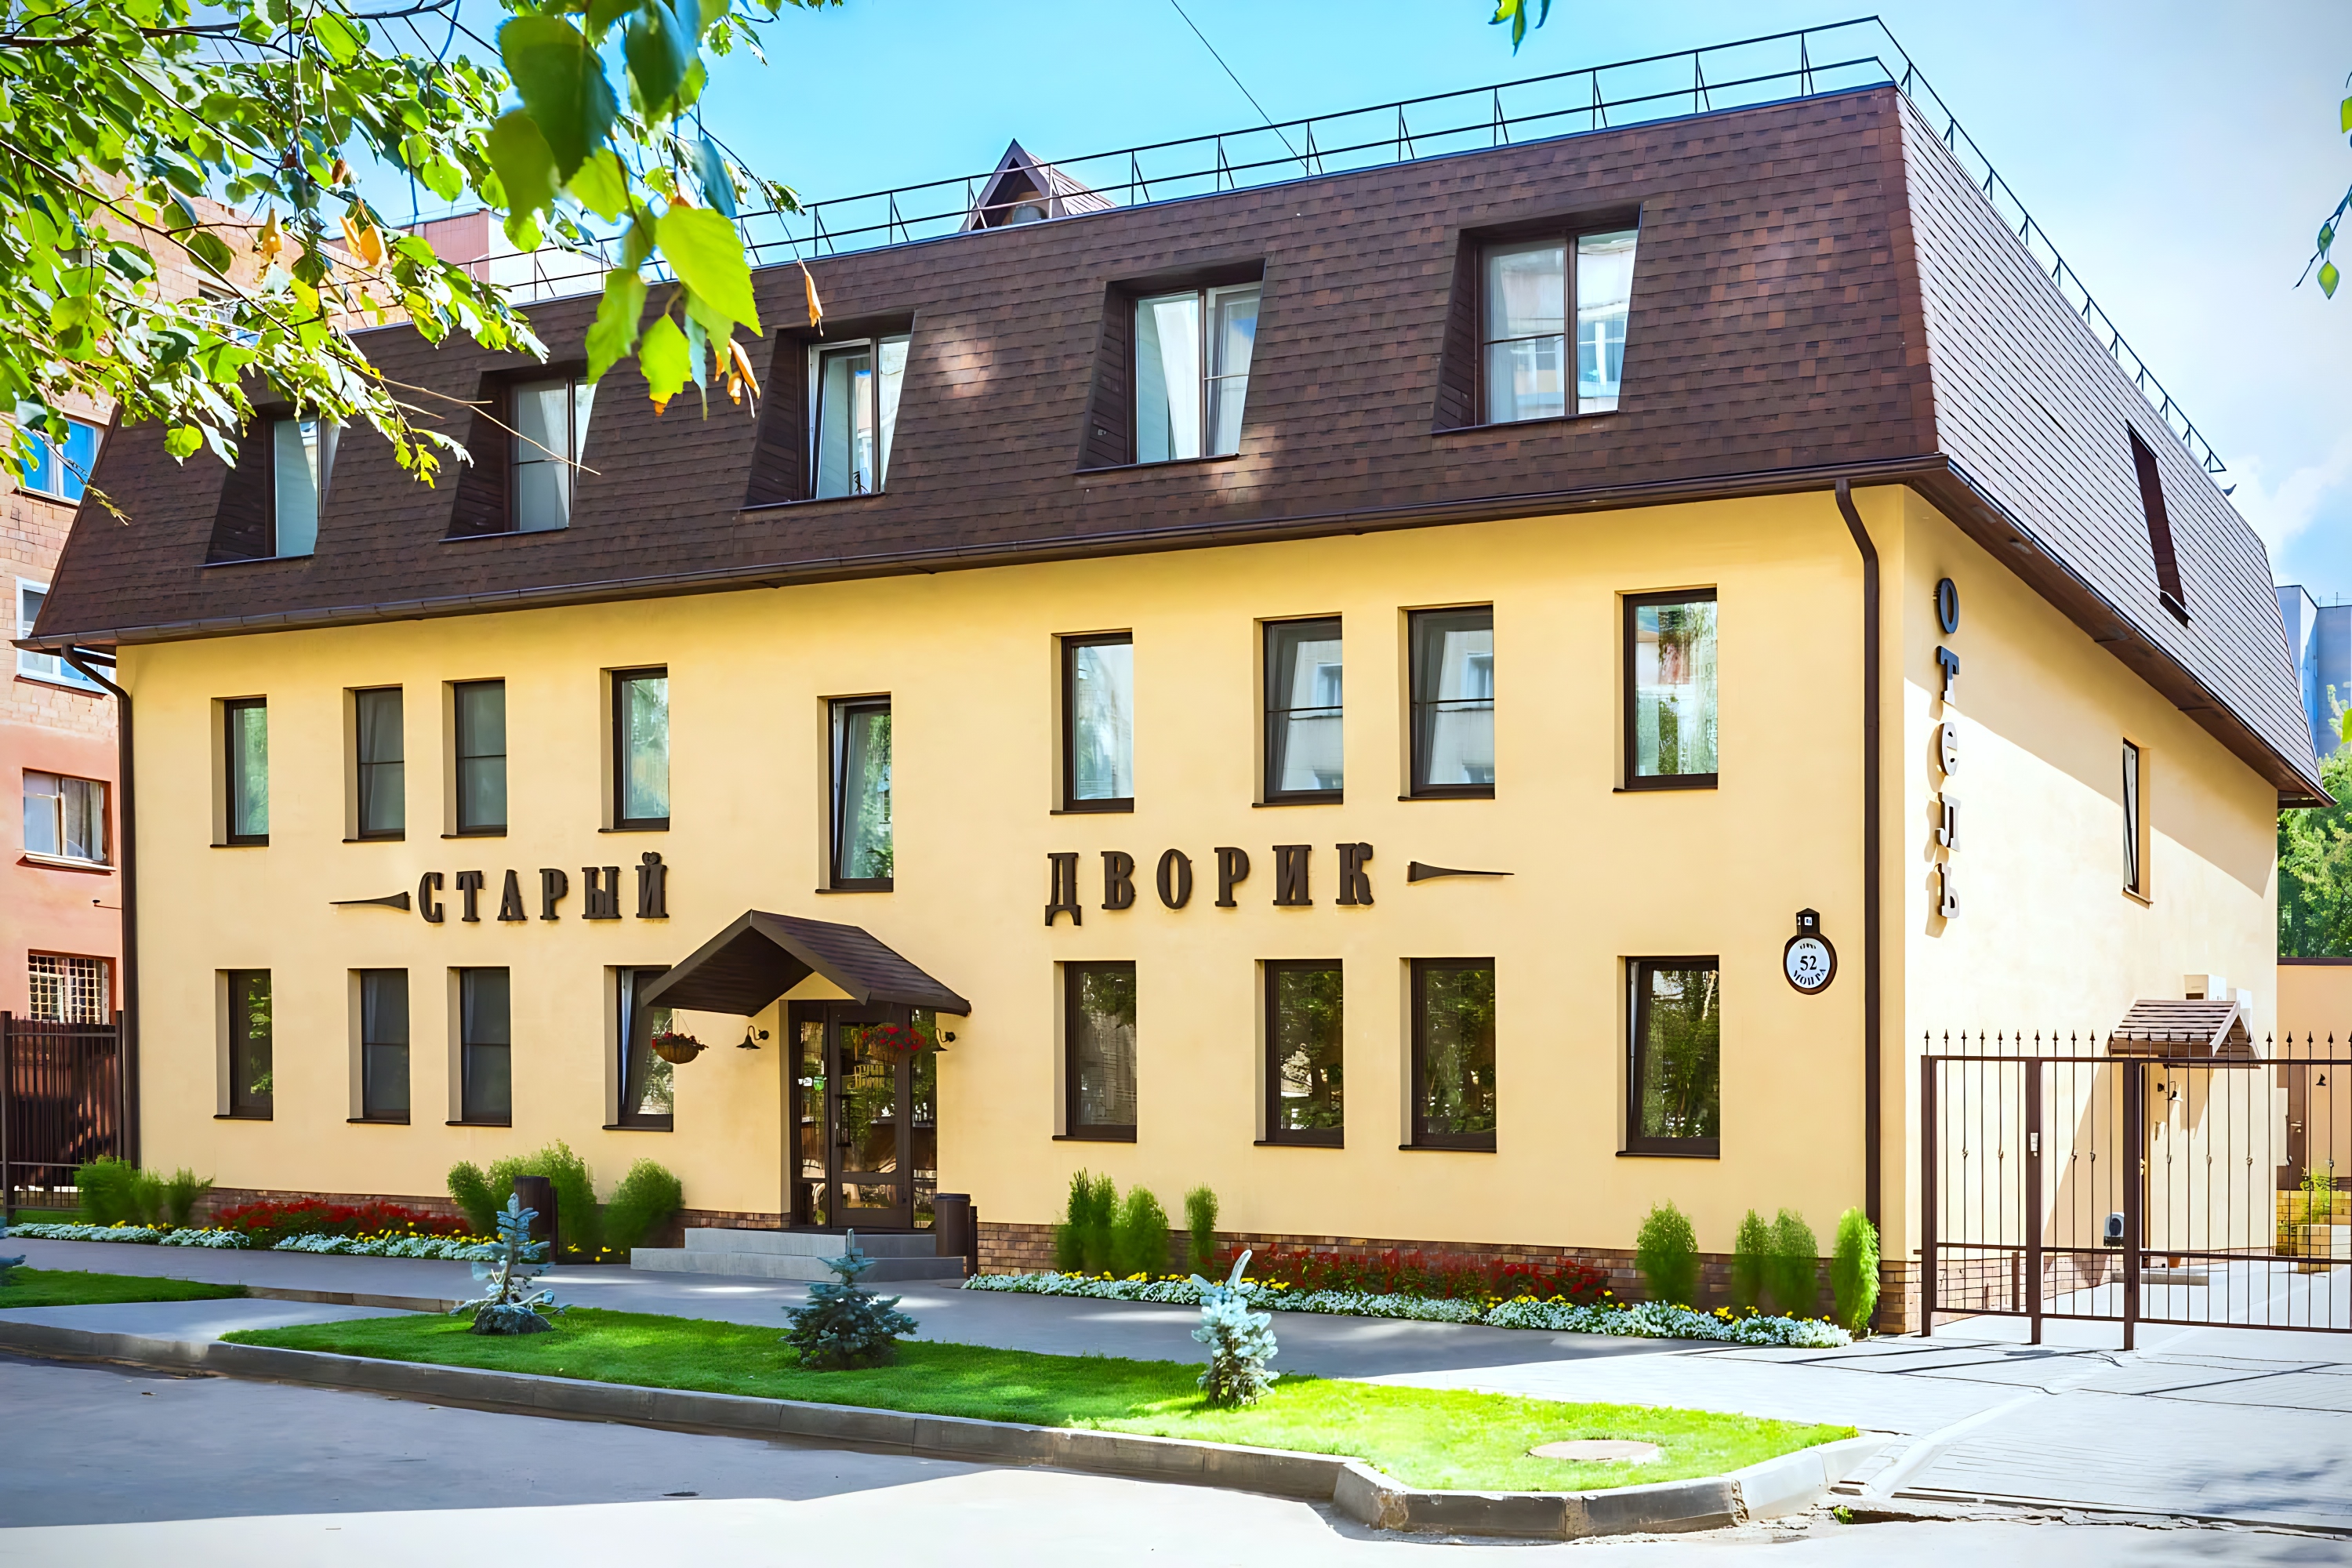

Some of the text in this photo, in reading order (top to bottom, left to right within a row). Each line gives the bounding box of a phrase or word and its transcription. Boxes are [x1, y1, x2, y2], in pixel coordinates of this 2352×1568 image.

[418, 841, 1374, 927] СТАРЫЙ ДВОРИК
[1799, 955, 1817, 971] 52
